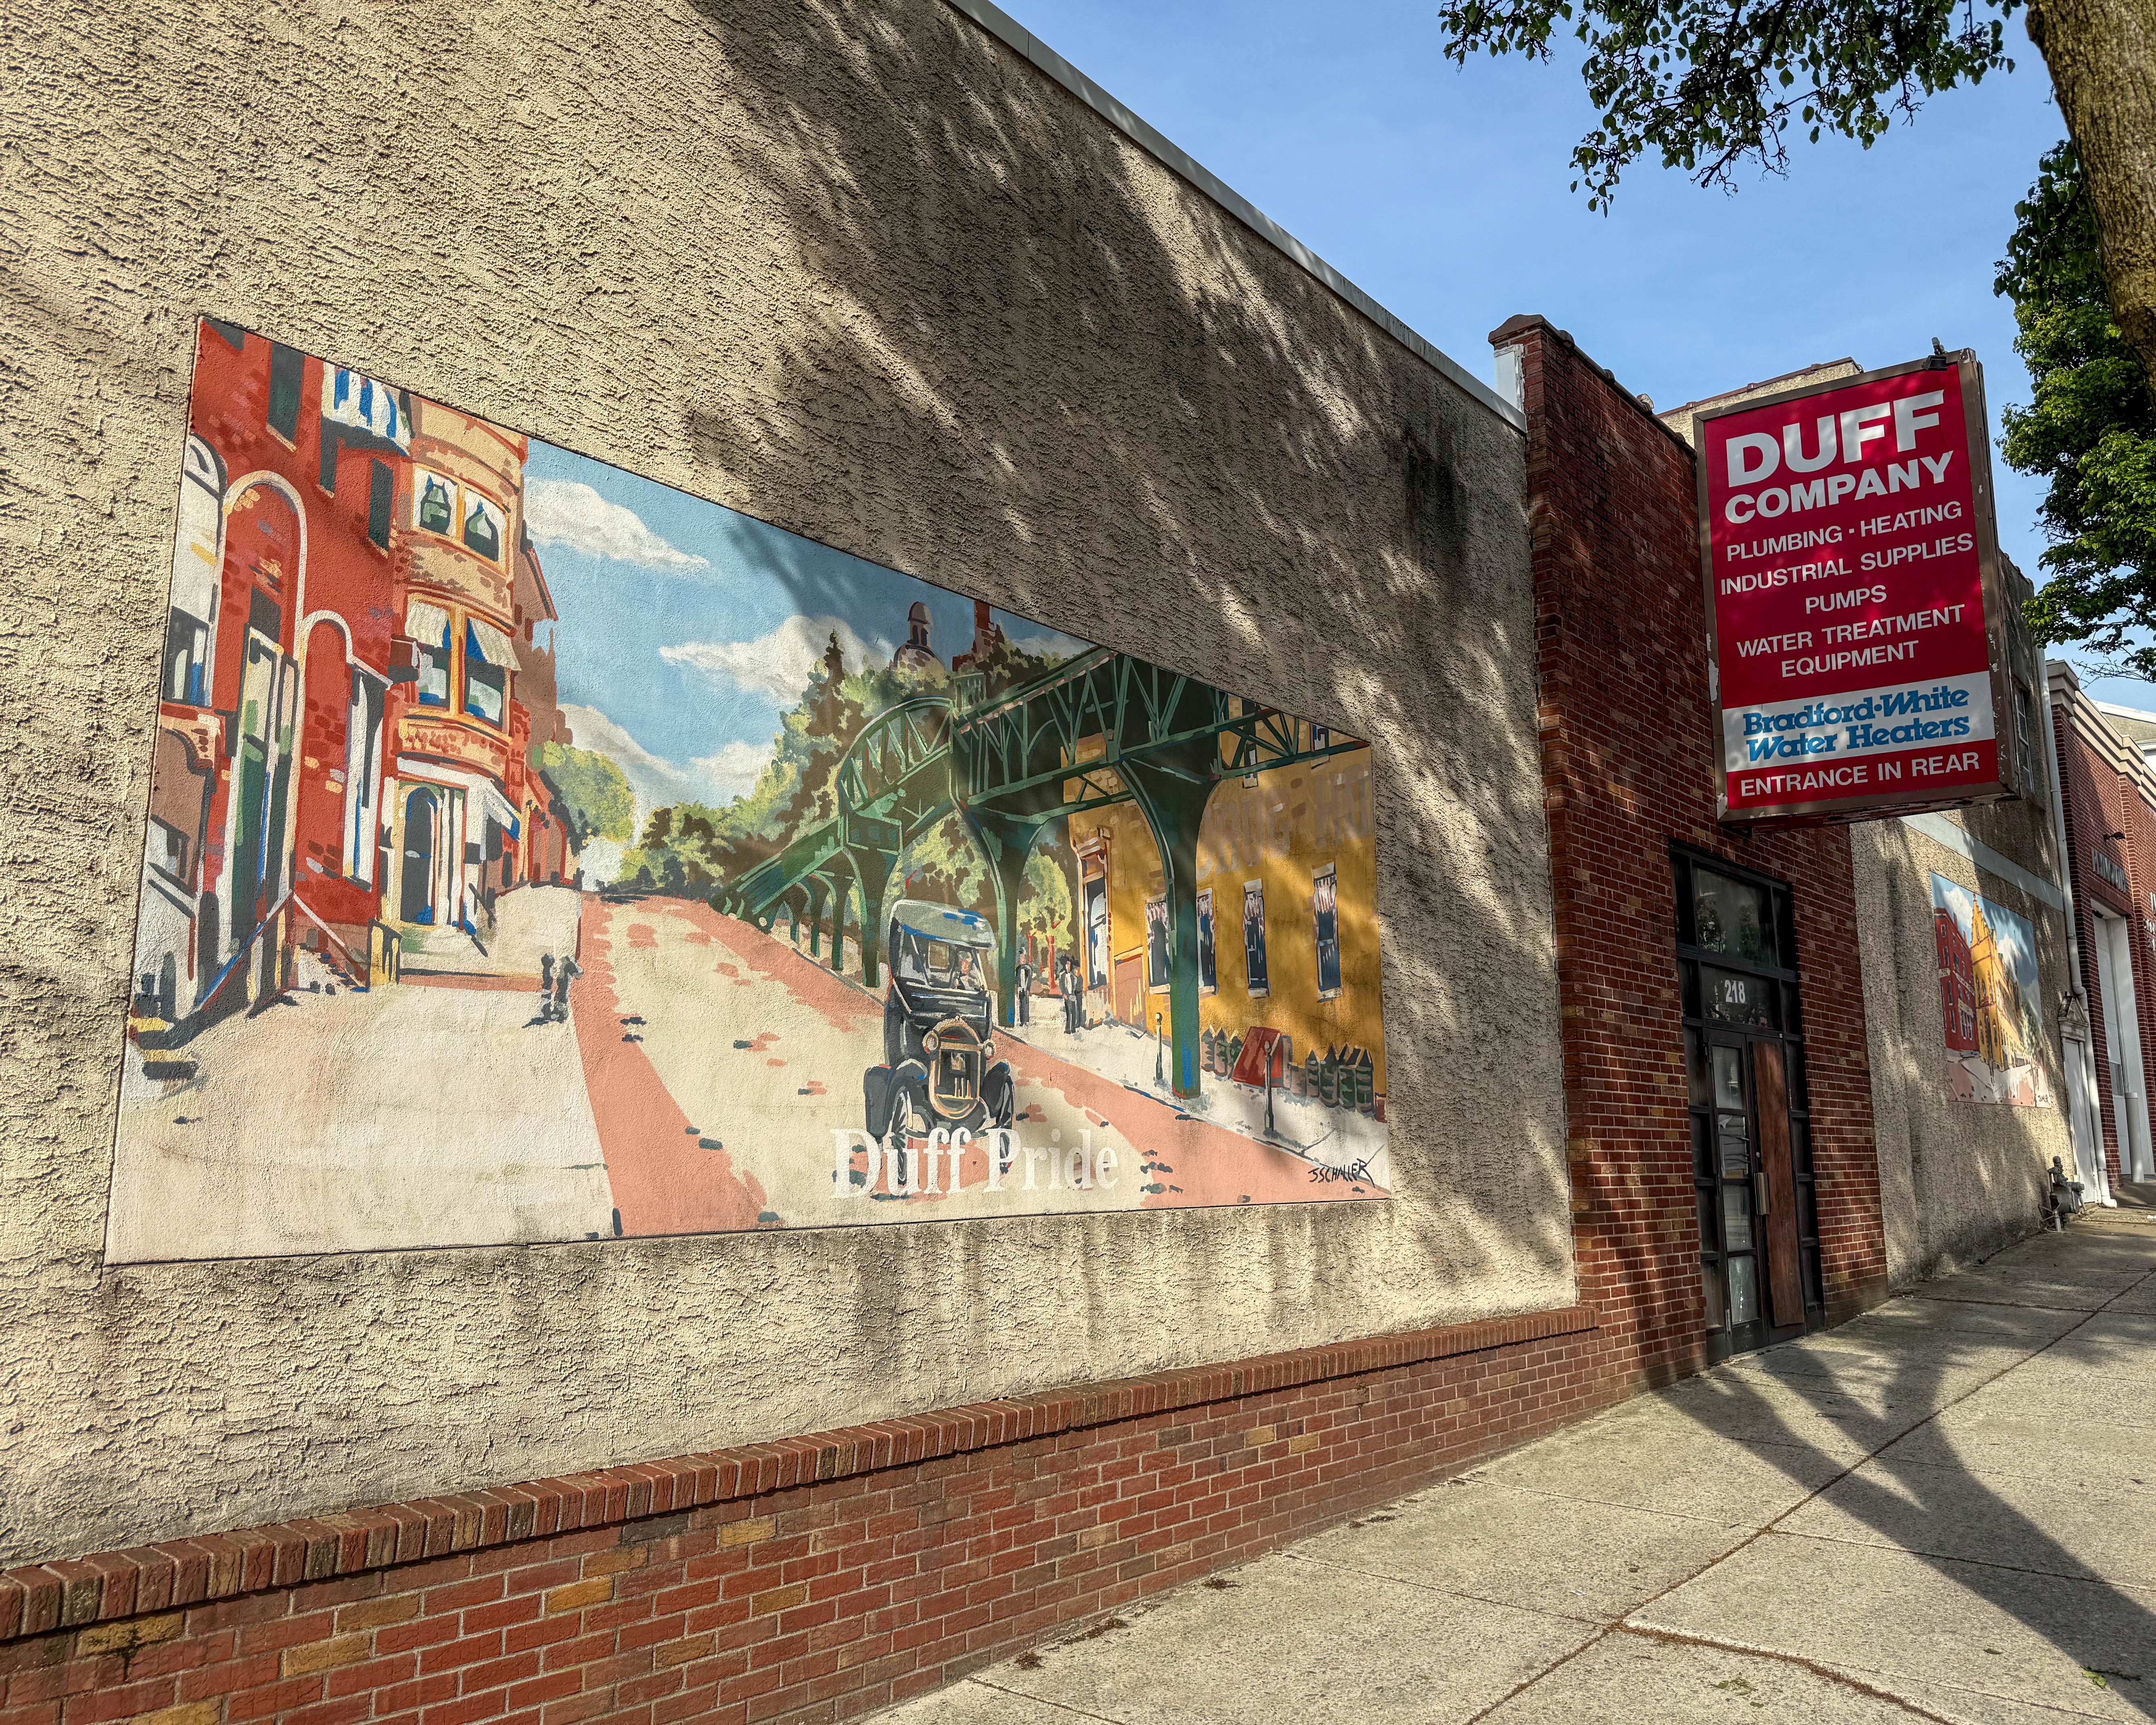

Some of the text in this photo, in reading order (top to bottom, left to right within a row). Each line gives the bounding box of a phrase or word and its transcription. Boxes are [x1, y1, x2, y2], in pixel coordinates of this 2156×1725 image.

[1726, 389, 1944, 488] DUFF
[1725, 450, 1953, 524] COMPANY
[1727, 501, 1962, 562] PLUMBING HEATING
[1721, 533, 1973, 595] INDUSTRIAL SUPPLIES
[1806, 585, 1887, 614] PUMPS
[1737, 604, 1965, 658] WATER TREATMENT
[1782, 641, 1919, 678] EQUIPMENT
[1747, 716, 1970, 762] Water Heaters
[1741, 752, 1980, 797] ENTRANCE IN REAR
[1724, 980, 1746, 1003] 218
[829, 1126, 1119, 1199] Duff Pride
